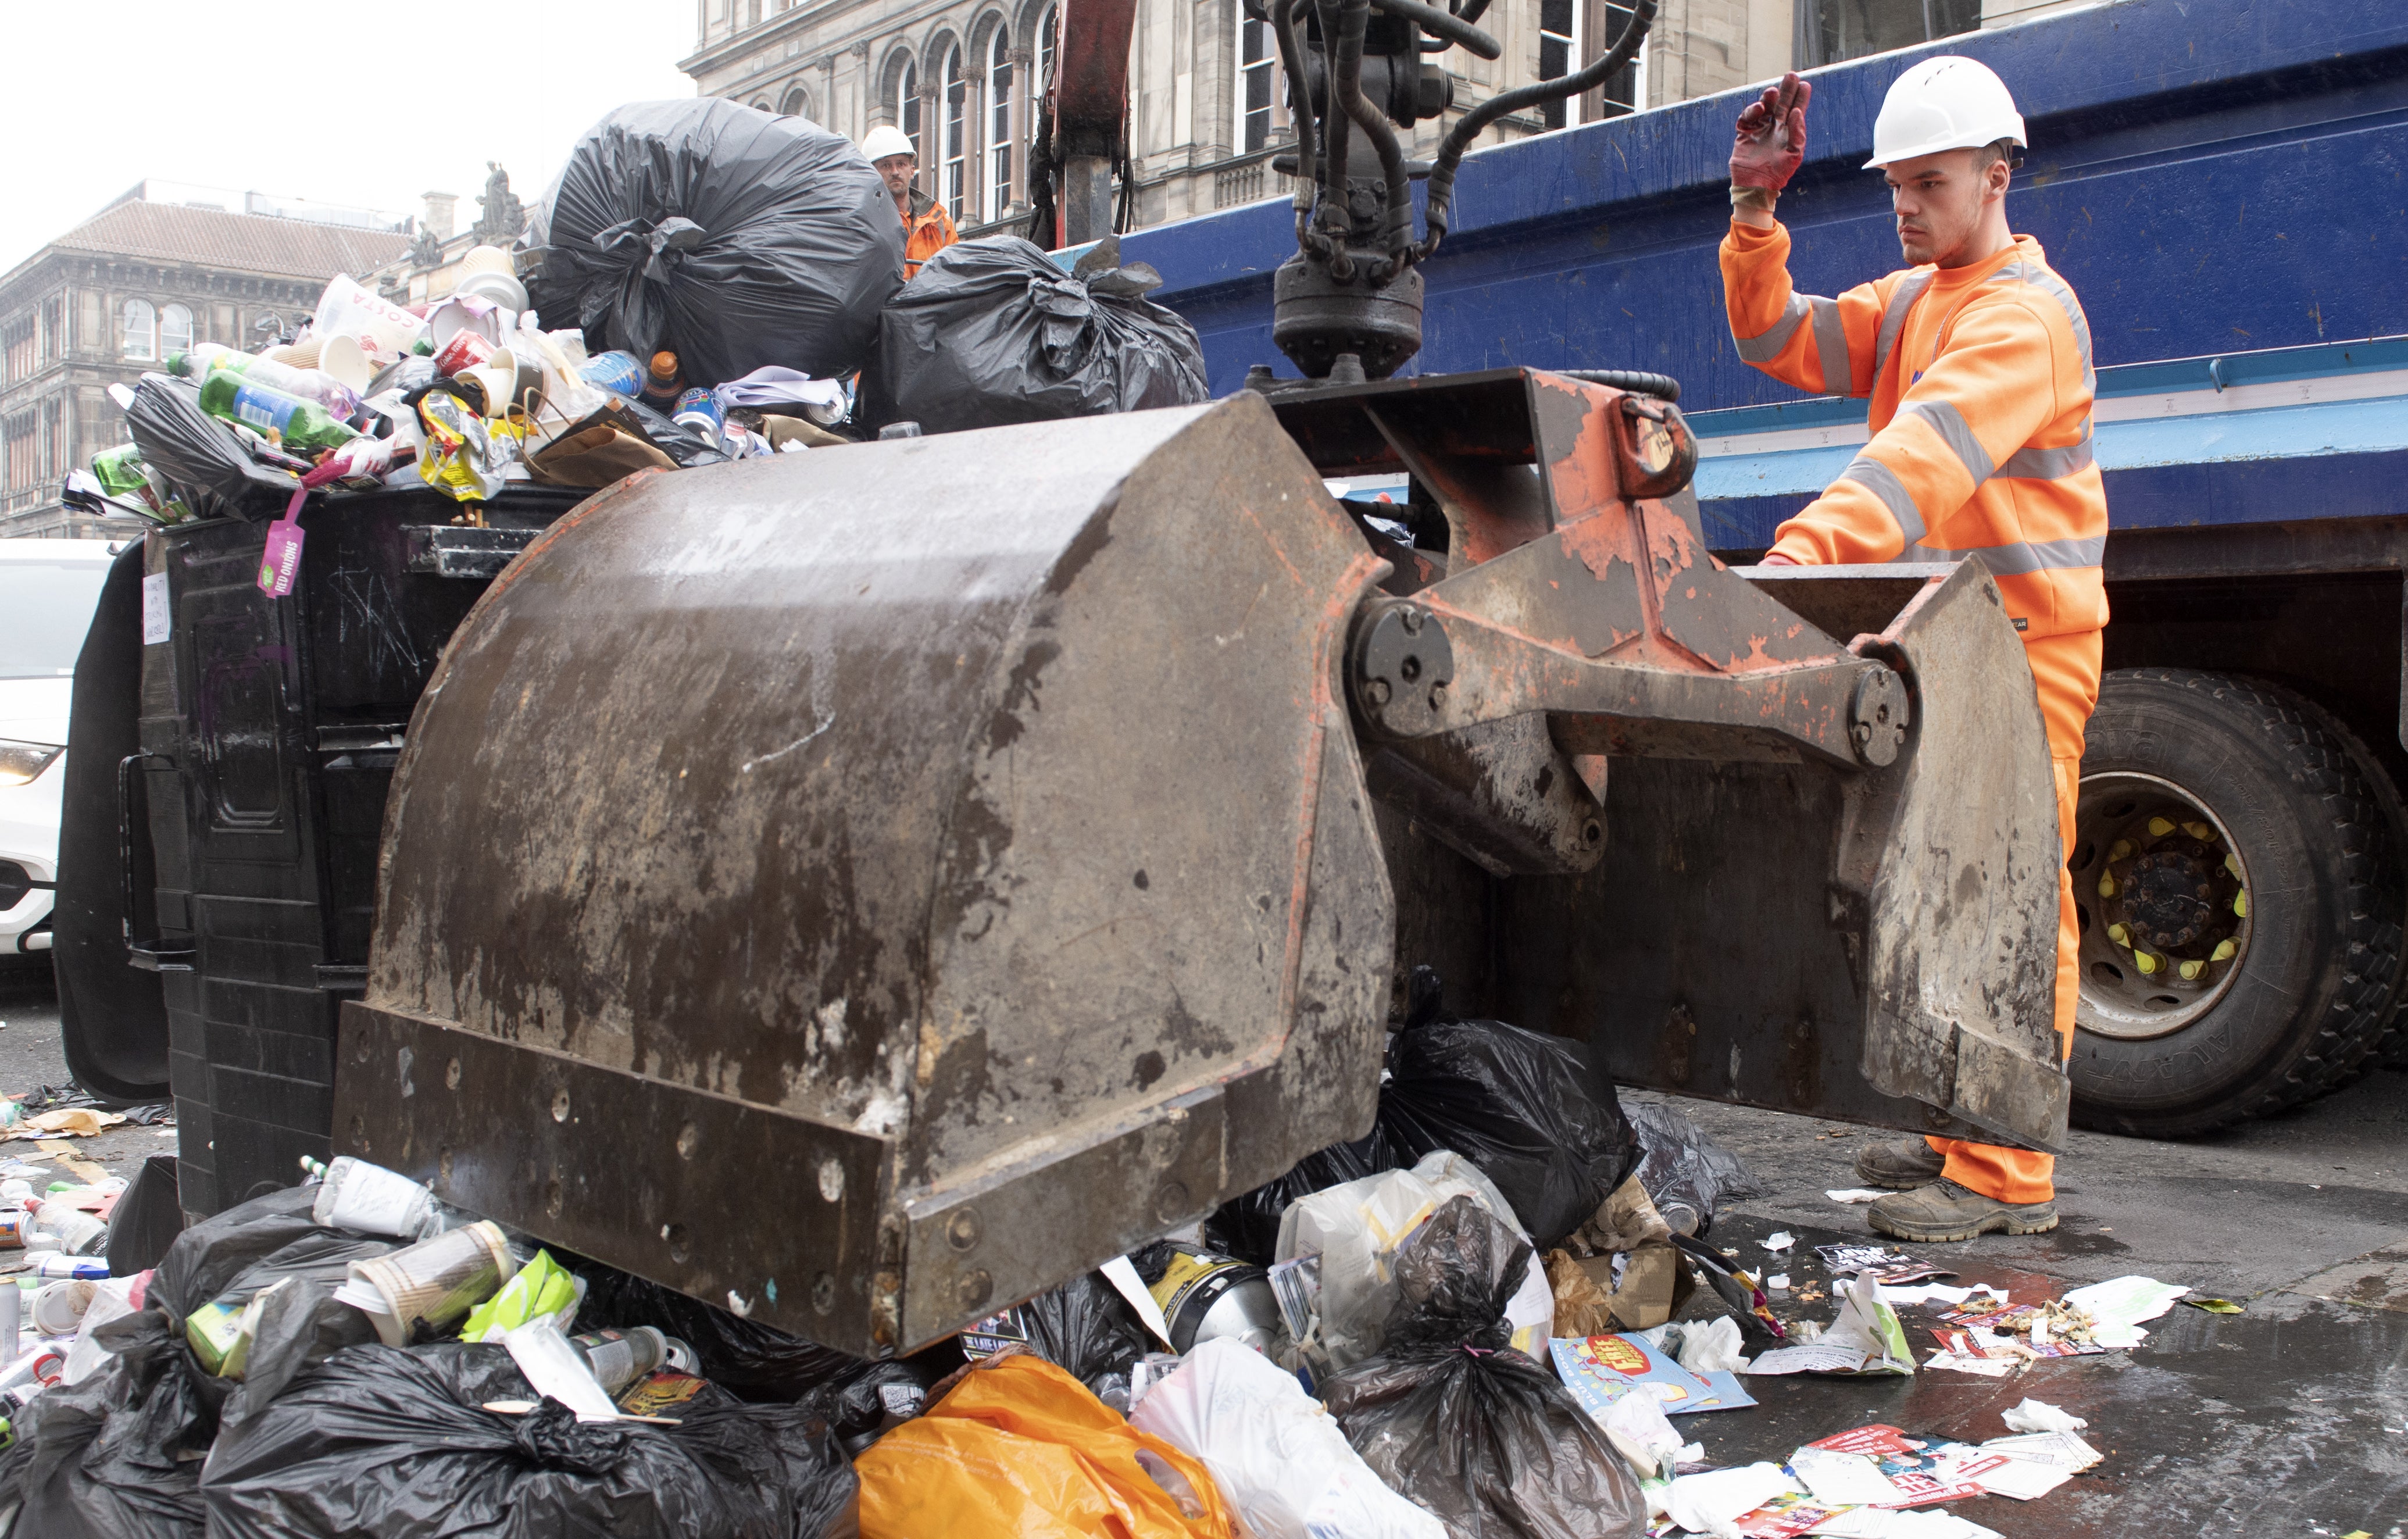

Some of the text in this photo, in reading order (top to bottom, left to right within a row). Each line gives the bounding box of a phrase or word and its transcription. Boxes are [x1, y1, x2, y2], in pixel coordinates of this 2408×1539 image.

[352, 292, 415, 328] COSTA
[440, 352, 453, 367] Coke
[274, 541, 298, 592] RED ONIONS
[974, 1337, 995, 1351] LATE
[1595, 1340, 1644, 1370] FREE
[1554, 1343, 1599, 1406] BLUE BOOK
[1910, 1487, 1961, 1504] IMPROVISED
